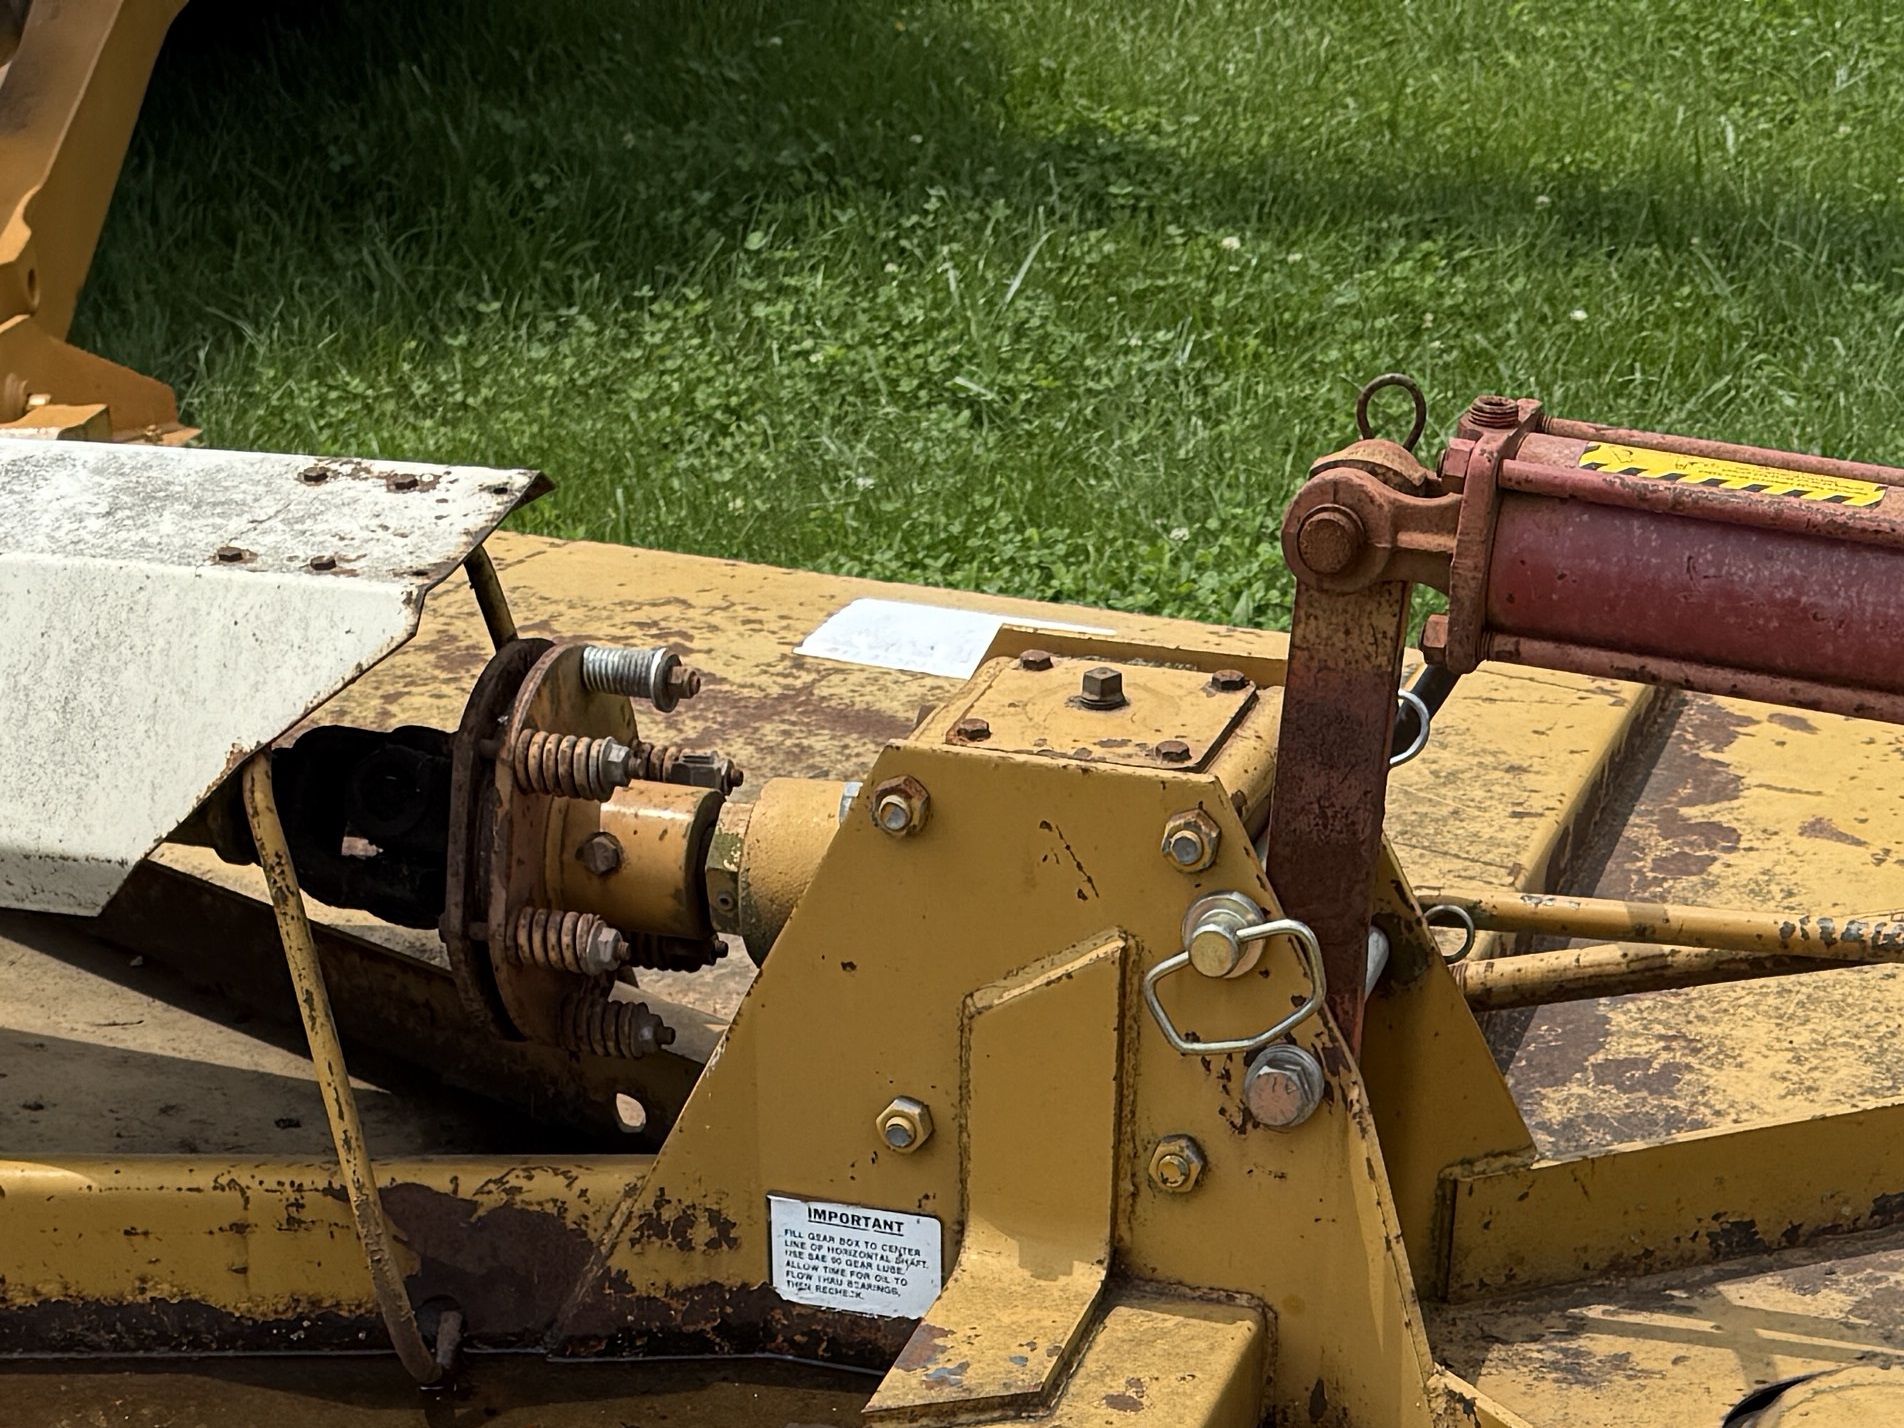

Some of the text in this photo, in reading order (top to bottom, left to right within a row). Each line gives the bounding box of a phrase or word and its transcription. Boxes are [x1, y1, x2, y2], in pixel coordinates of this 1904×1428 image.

[808, 1206, 904, 1233] IMPORTANT
[784, 1229, 921, 1257] FILL GEAR BOX TO CENTER
[784, 1240, 806, 1250] LINE
[810, 1243, 823, 1251] OF
[827, 1246, 891, 1263] HORIZONTAL
[784, 1250, 804, 1259] USE
[808, 1252, 827, 1262] SAE
[845, 1259, 873, 1270] GEAR
[785, 1260, 908, 1287] ALLOW TIME FOR OIL TO
[785, 1270, 813, 1281] FLOW
[817, 1275, 843, 1287] THRU
[786, 1280, 812, 1291] THEN
